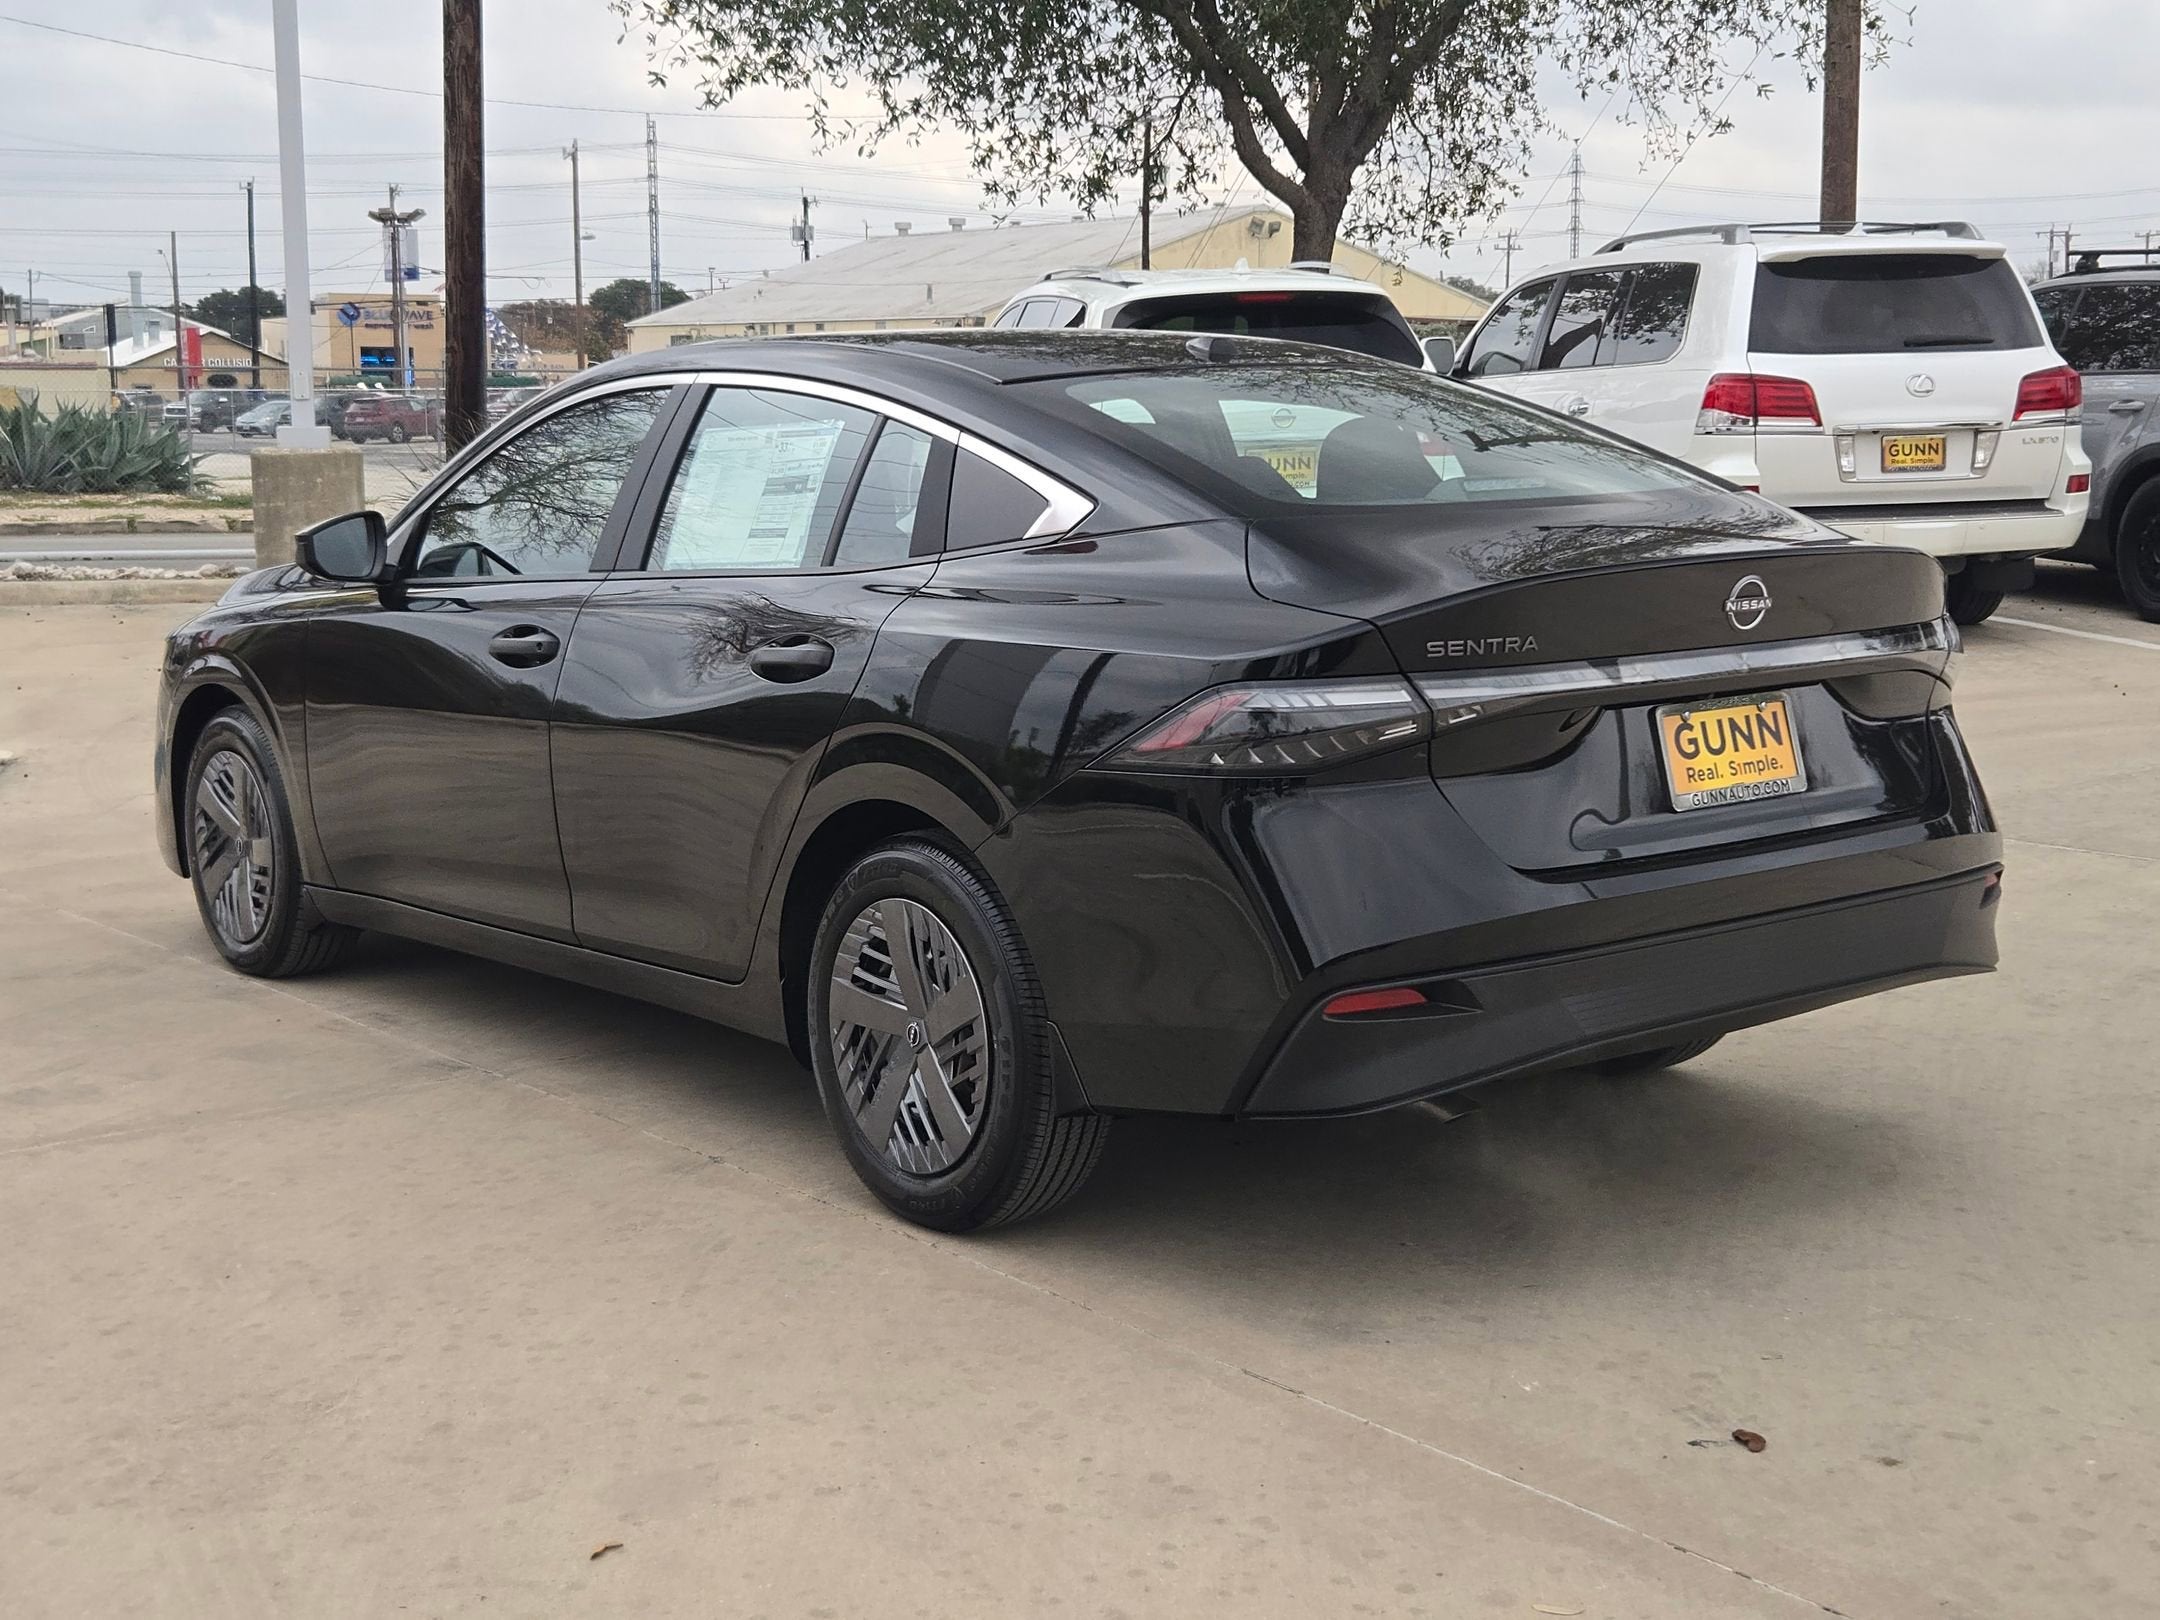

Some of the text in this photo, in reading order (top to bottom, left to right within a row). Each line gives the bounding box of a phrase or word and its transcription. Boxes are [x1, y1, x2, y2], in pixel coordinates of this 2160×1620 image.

[208, 358, 253, 367] COLLISIO
[1888, 442, 1940, 457] GUNN
[1268, 457, 1311, 471] UNN
[1725, 598, 1772, 611] NISSAN
[1426, 635, 1539, 658] SENTRA
[1674, 711, 1784, 760] GUNN
[1686, 762, 1724, 784] Real.
[1692, 780, 1791, 807] GUNNAUTO.COM
